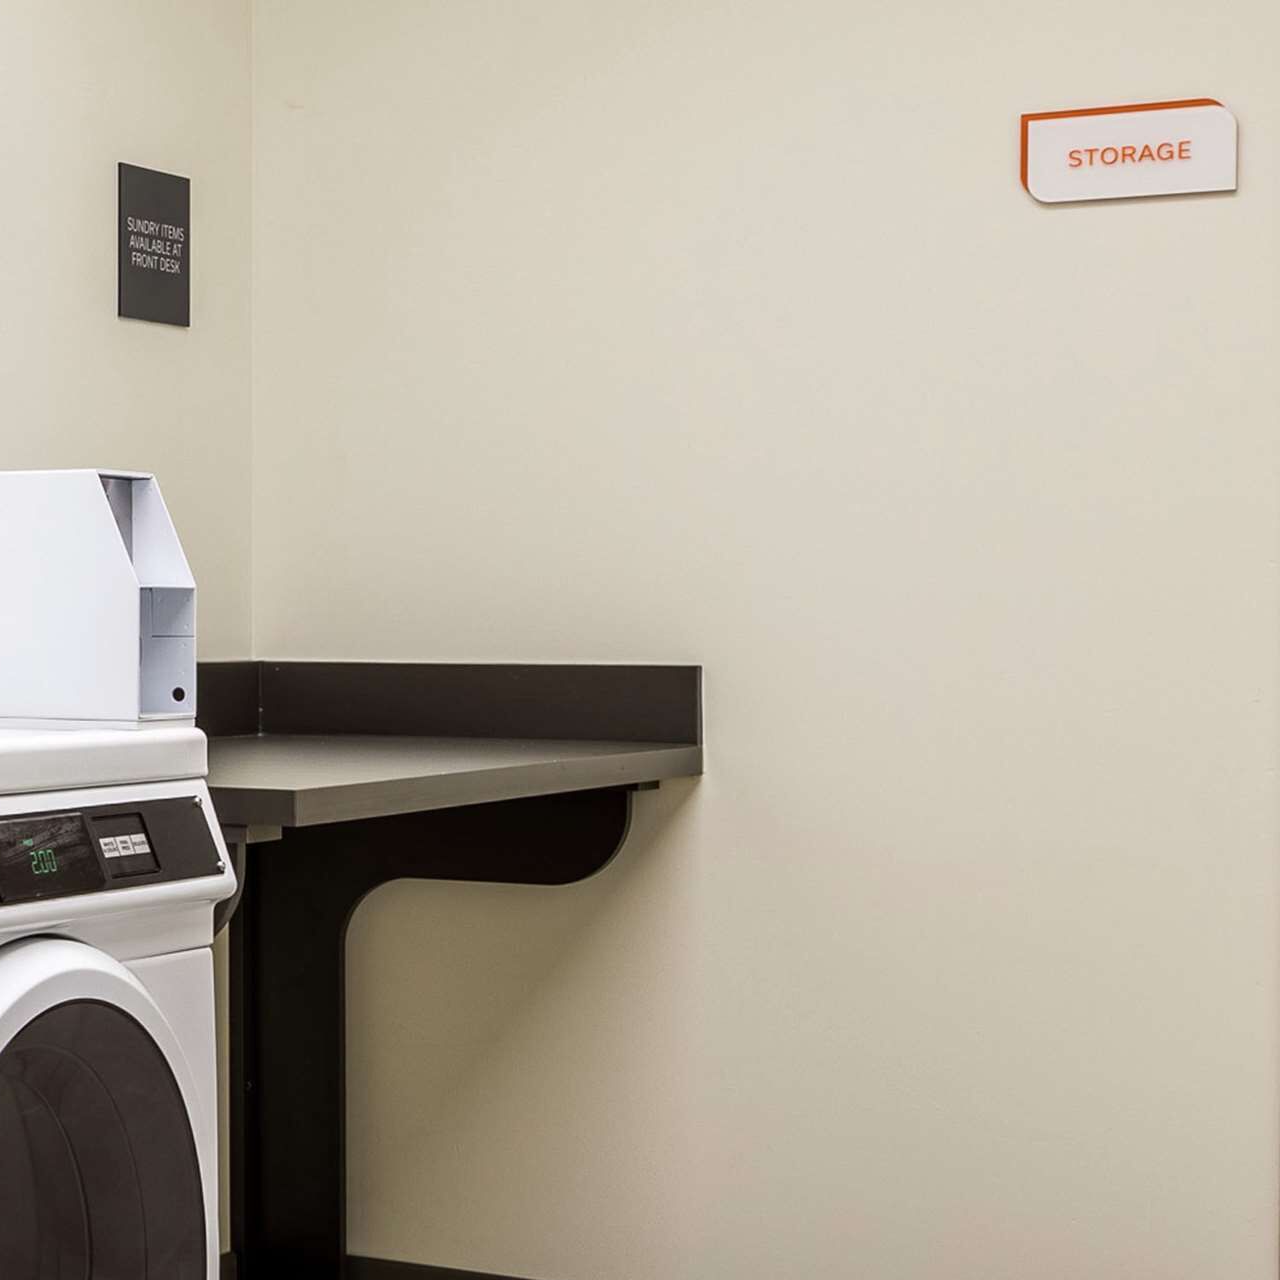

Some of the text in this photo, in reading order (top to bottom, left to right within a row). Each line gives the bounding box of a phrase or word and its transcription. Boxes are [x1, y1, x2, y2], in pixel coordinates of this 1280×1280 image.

[1068, 140, 1192, 168] STORAGE
[127, 216, 185, 242] SUNDRY ITEMS
[130, 234, 182, 257] AVAILABLE AT
[131, 251, 181, 274] FRONT DESK
